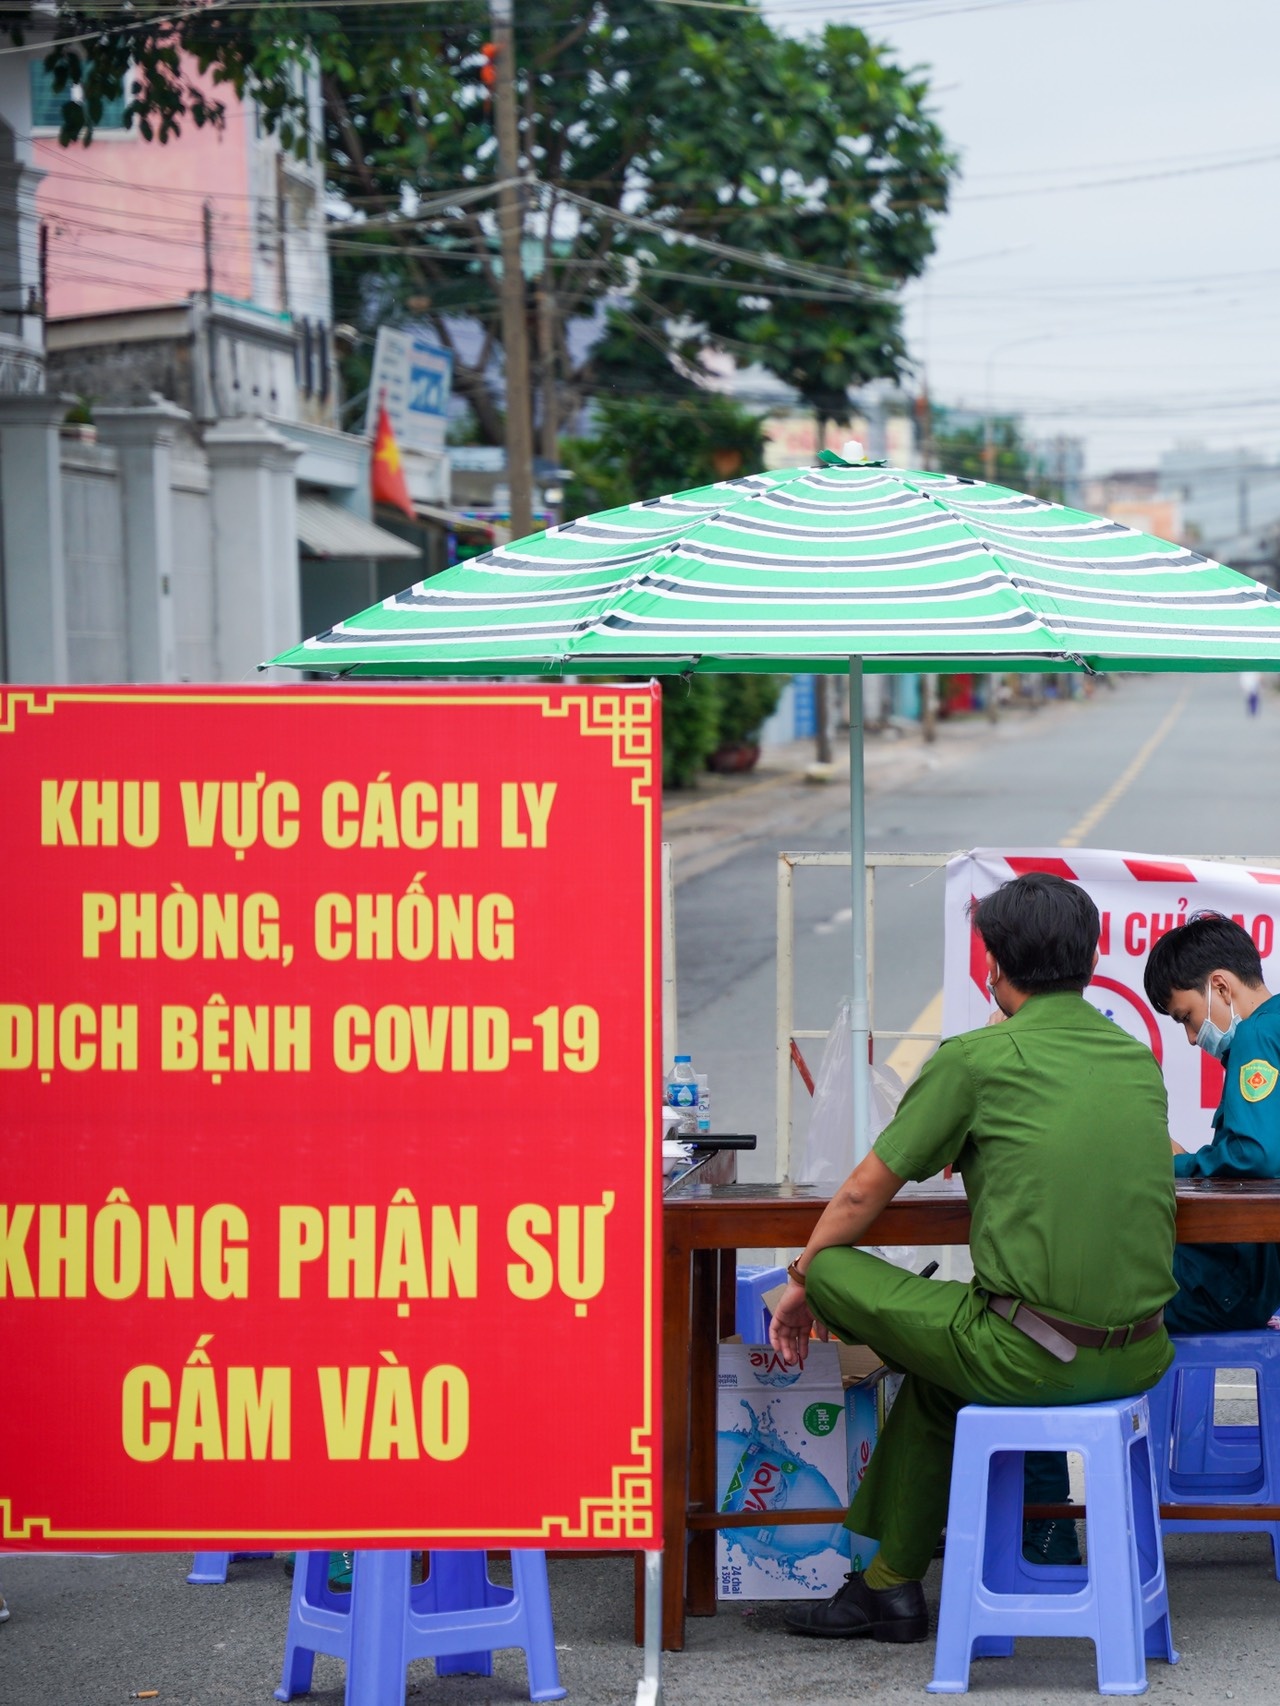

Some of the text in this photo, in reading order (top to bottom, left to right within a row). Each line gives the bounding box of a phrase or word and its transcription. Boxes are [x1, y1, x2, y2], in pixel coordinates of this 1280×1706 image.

[41, 771, 558, 861] KHU VỰC CÁCH LY
[82, 871, 515, 967] PHÒNG, CHỐNG
[0, 993, 600, 1084] DỊCH BỆNH COVID-19
[0, 1187, 615, 1317] KHÔNG PHẬN SỰ
[122, 1334, 469, 1462] CẤM VÀO
[816, 1409, 830, 1431] pH:8
[741, 1462, 781, 1511] laVi
[721, 1571, 731, 1585] 350
[722, 1585, 731, 1595] ml
[731, 1565, 742, 1594] 24 chai
